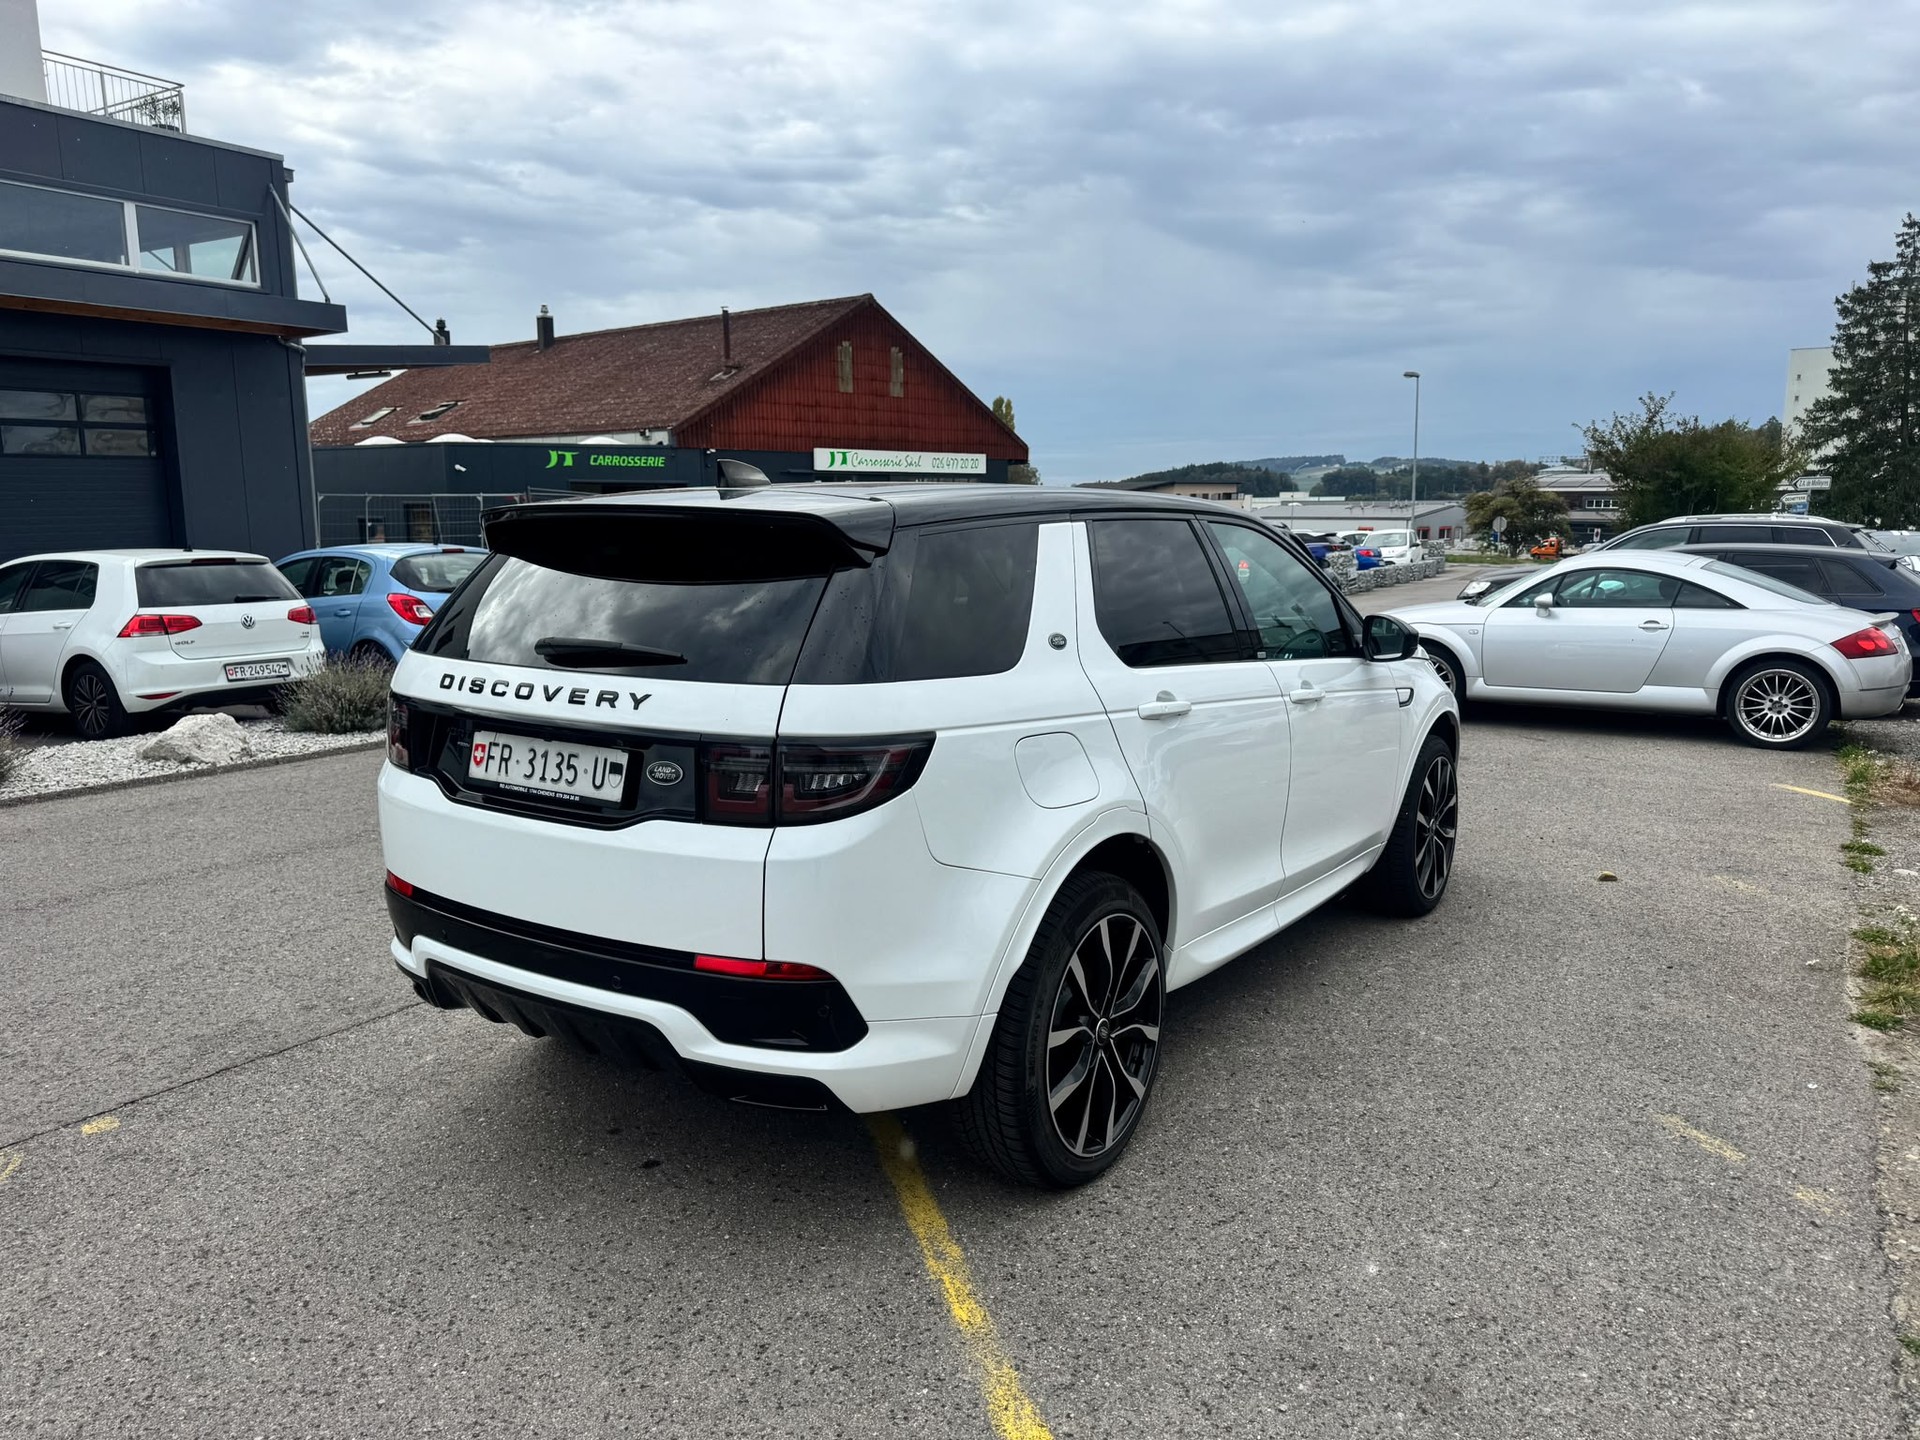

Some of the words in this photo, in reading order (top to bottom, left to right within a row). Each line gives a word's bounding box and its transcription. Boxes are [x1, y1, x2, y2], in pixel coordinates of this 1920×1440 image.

[545, 450, 579, 468] JT
[590, 455, 666, 467] CARROSSERIE
[827, 451, 852, 468] JT
[851, 452, 903, 468] Carrosserie
[931, 456, 945, 469] 026
[945, 457, 958, 470] 477
[960, 457, 969, 469] 20
[970, 458, 979, 469] 20
[439, 673, 652, 710] DISCOVERY
[523, 747, 580, 786] 3135
[654, 772, 676, 780] ROVER
